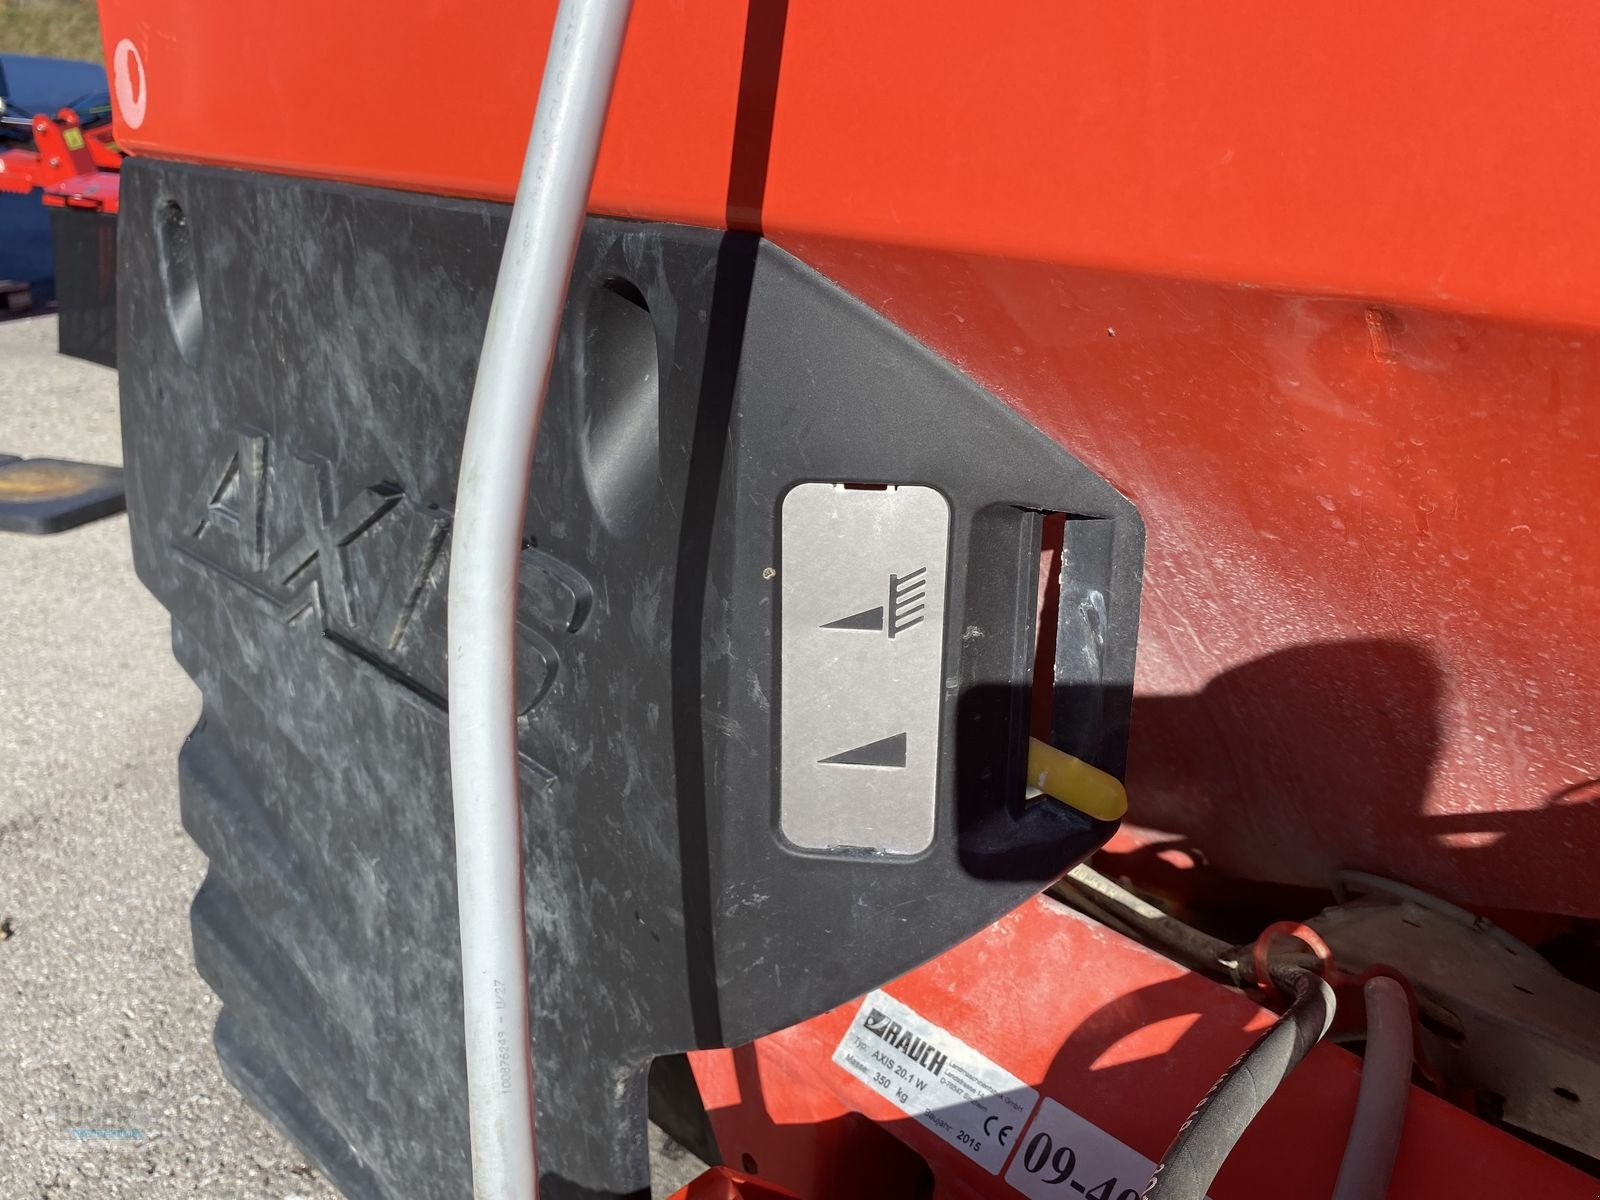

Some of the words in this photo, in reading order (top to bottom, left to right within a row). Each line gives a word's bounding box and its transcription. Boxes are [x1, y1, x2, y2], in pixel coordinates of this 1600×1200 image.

[883, 1021, 948, 1076] RAUCH
[872, 1050, 895, 1070] AXIS
[894, 1065, 915, 1083] 20.1
[915, 1078, 928, 1091] W
[873, 1072, 891, 1089] 350
[895, 1087, 909, 1104] kg
[956, 1130, 982, 1152] 2015
[1023, 1132, 1143, 1200] 09-4
